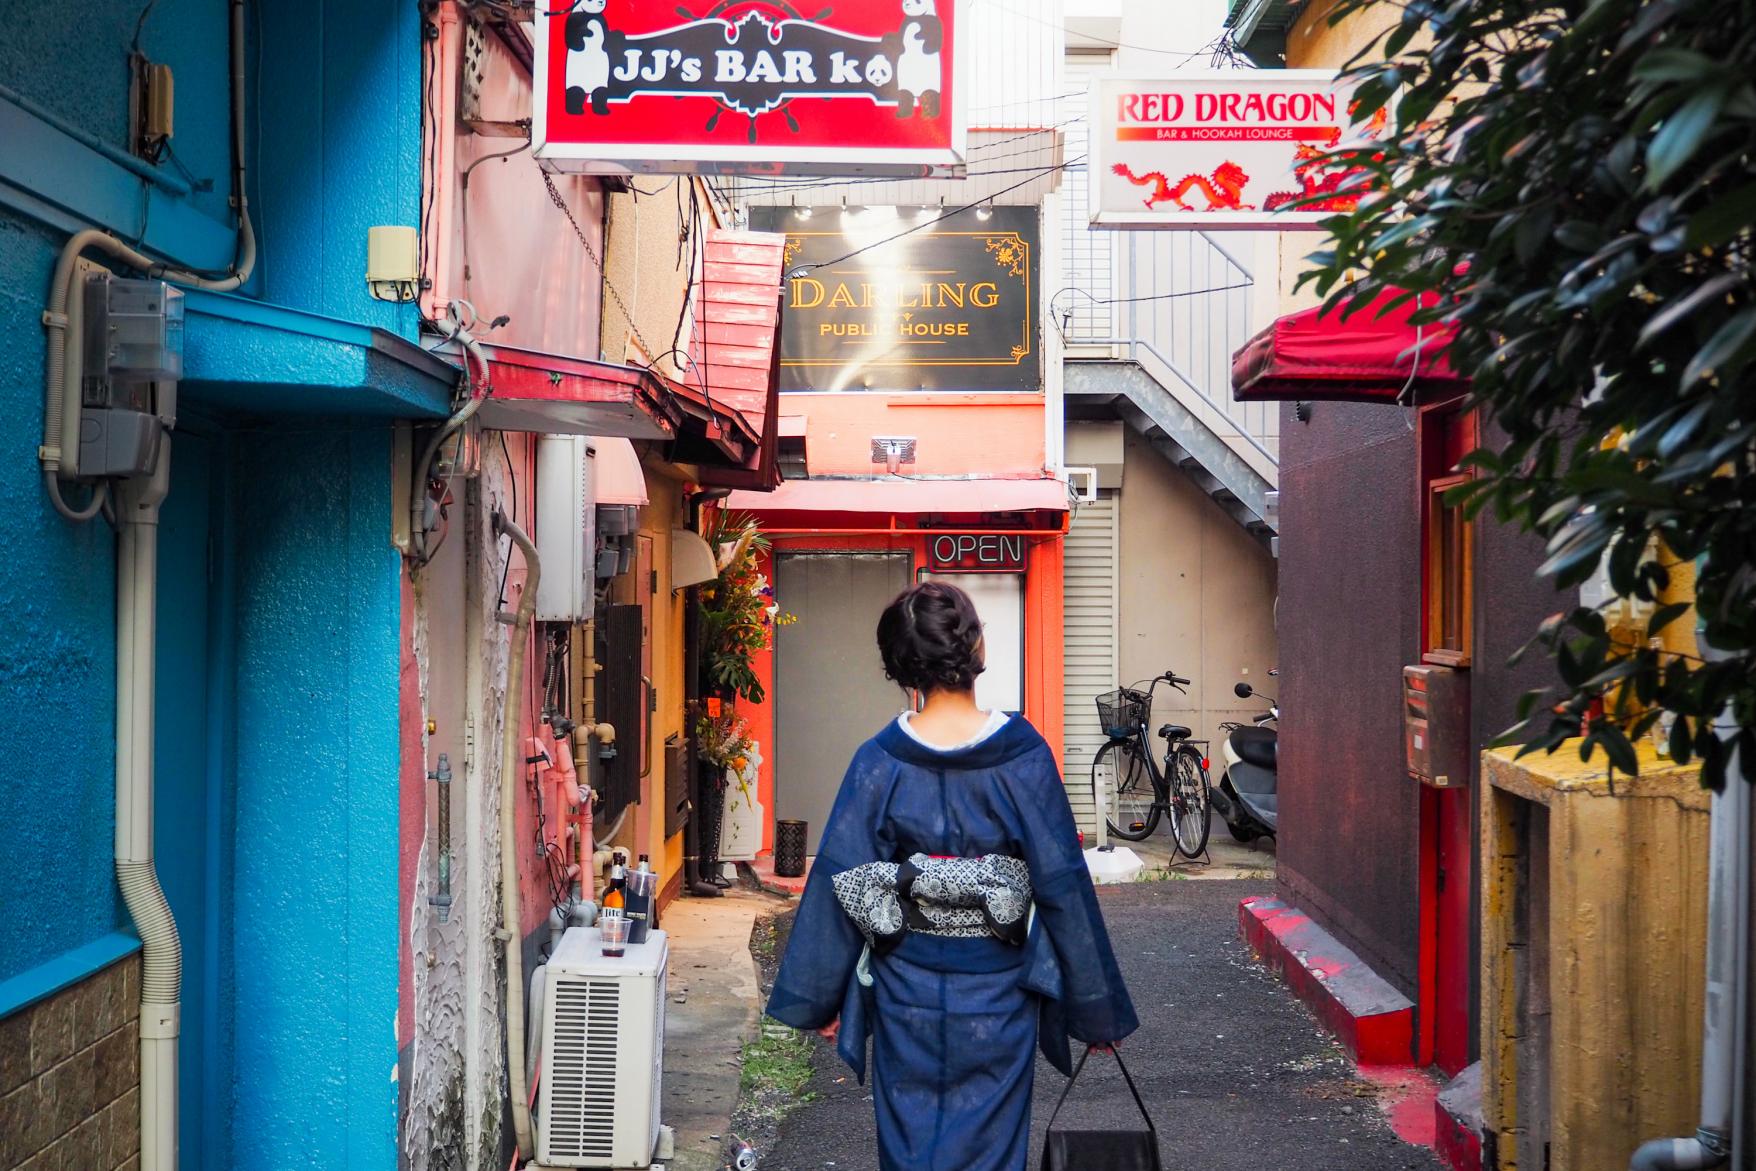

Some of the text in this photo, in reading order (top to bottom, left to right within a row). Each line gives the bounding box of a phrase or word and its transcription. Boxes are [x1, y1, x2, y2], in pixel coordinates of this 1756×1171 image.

[614, 49, 702, 83] JJ's
[714, 49, 817, 85] BAR
[1117, 93, 1335, 122] RED DRAGON
[1156, 128, 1293, 139] BAR & HOOKAH LOUNGE
[820, 322, 969, 336] PUBLI HOUSE
[934, 535, 1021, 562] OPEN
